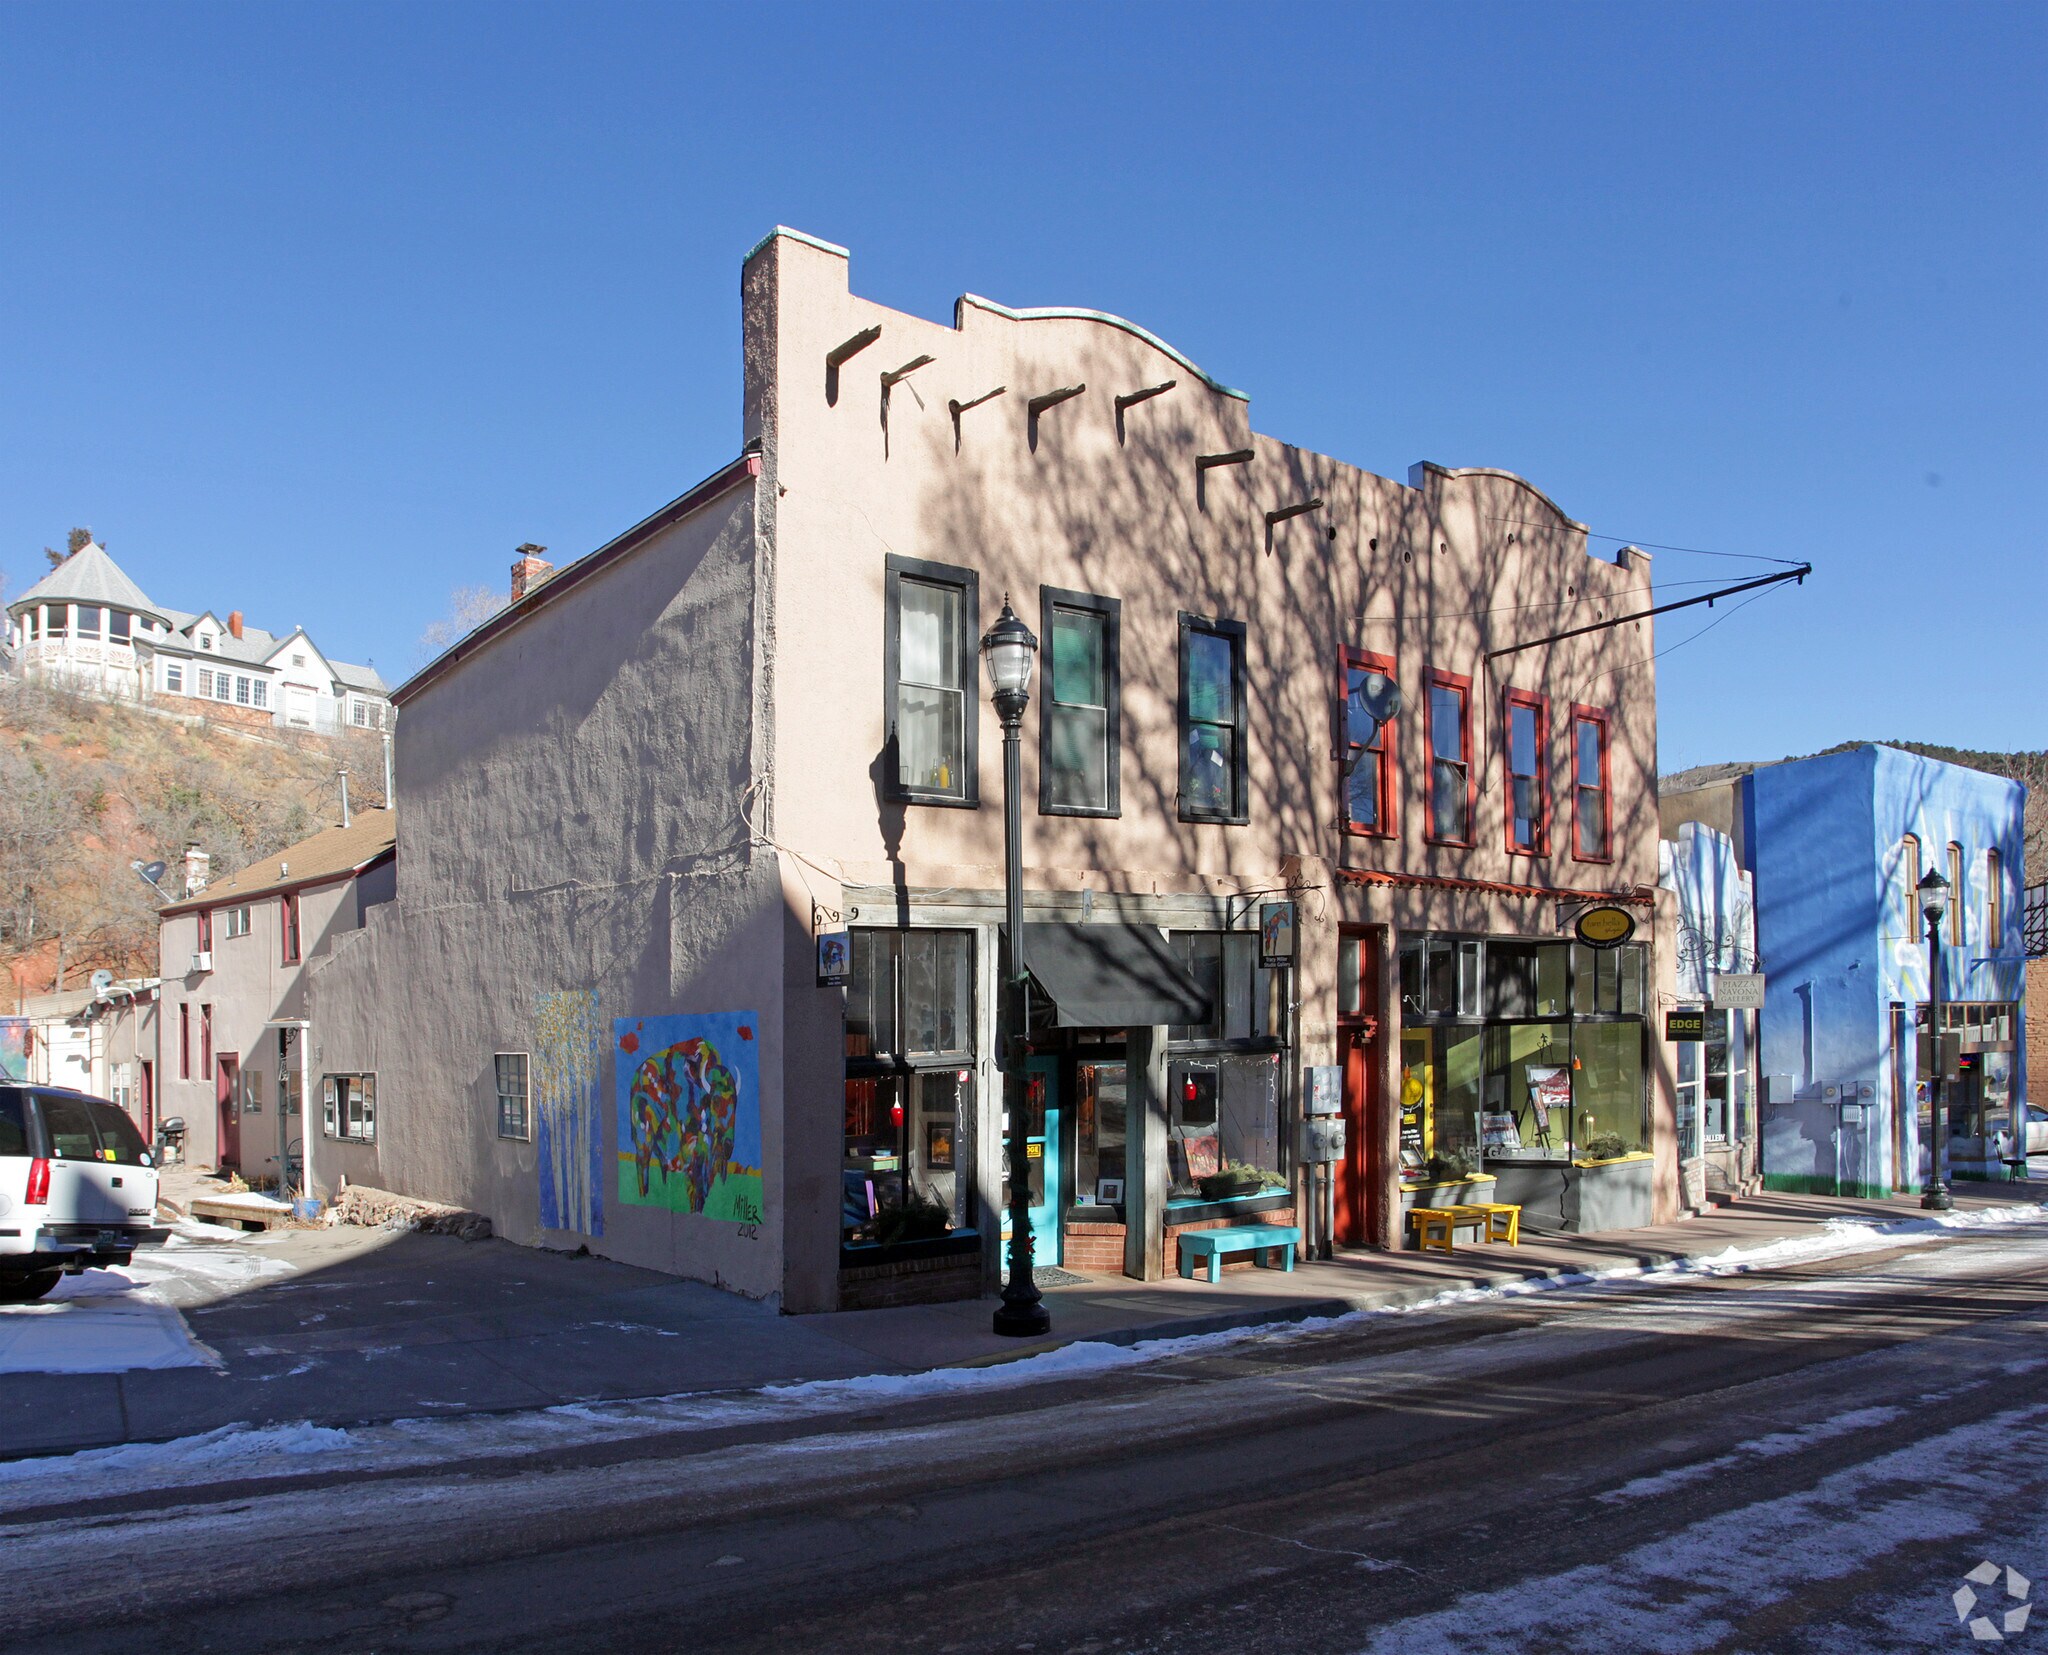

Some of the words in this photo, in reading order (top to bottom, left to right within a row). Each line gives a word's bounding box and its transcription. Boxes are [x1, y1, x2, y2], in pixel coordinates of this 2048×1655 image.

[1722, 980, 1755, 988] PIAZZA
[1669, 1019, 1701, 1029] EDGE
[737, 1222, 758, 1240] 2012
